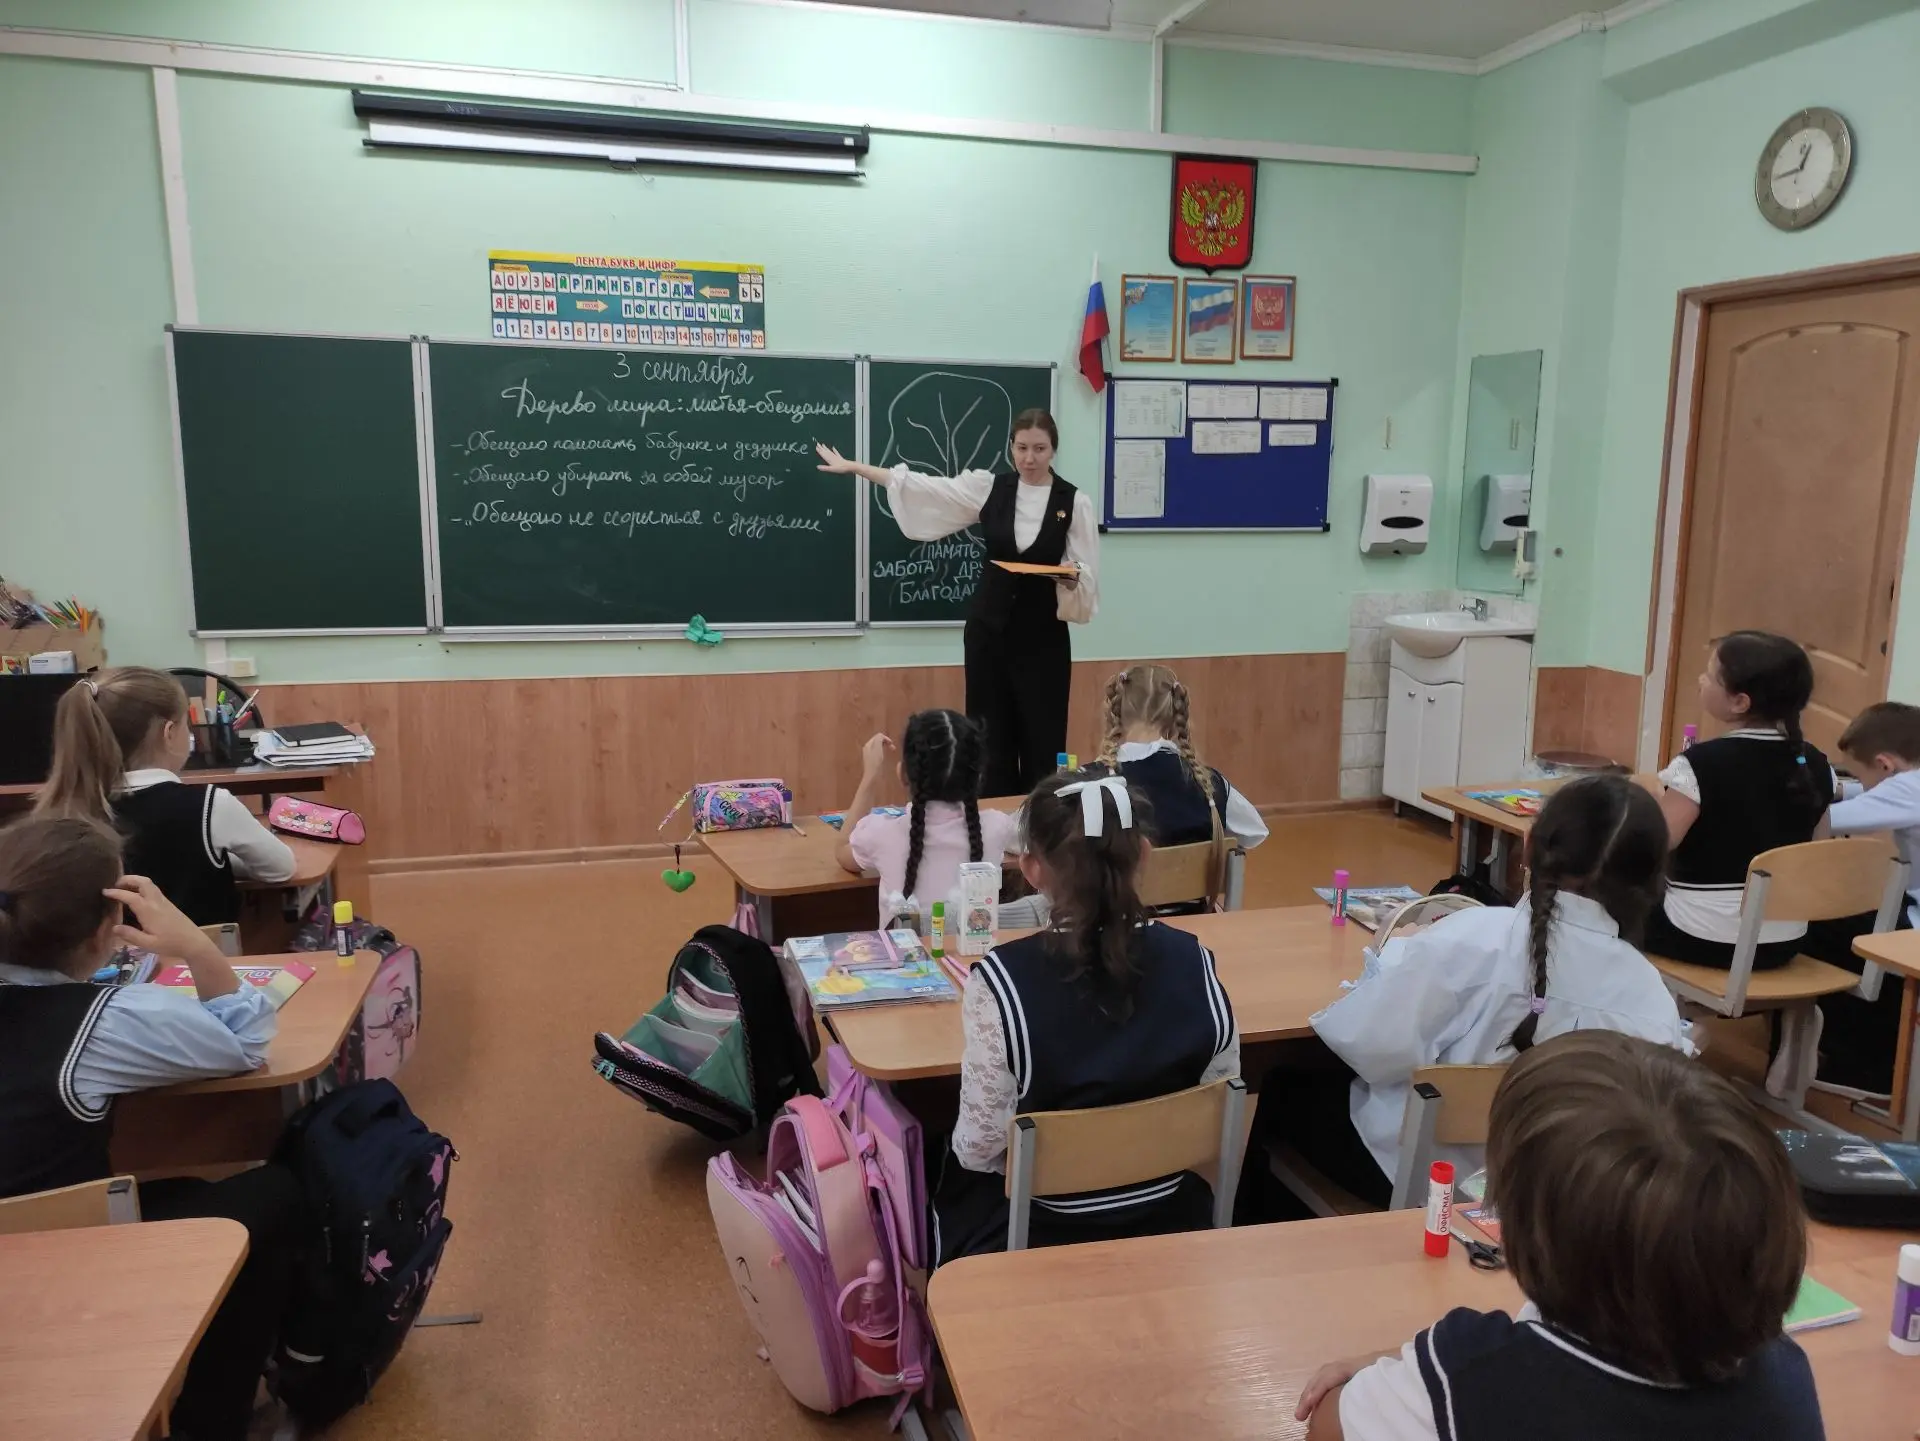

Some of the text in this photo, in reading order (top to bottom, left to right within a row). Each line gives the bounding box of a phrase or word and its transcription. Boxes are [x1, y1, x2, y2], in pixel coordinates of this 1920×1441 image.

[576, 256, 677, 270] ЛЕНТА БУКВ И ЦИФР
[627, 329, 636, 338] 10
[641, 330, 649, 339] 11
[653, 330, 663, 339] 12
[665, 330, 675, 340] 13
[679, 331, 688, 340] 14
[691, 331, 700, 341] 15
[703, 332, 713, 341] 16
[716, 333, 725, 342] 17
[728, 333, 737, 343] 18
[741, 334, 750, 343] 19
[753, 334, 763, 344] 20
[613, 352, 754, 393] 3 сентября
[501, 378, 596, 424] Дерево
[553, 439, 637, 451] помогать
[645, 431, 713, 460] бабушке
[716, 441, 727, 450] и
[552, 463, 632, 496] убирать
[640, 471, 658, 485] за
[663, 464, 713, 484] собой
[569, 511, 594, 526] не
[603, 510, 703, 538] ссориться
[713, 511, 724, 524] с
[927, 543, 980, 560] ПАМЯТЬ
[873, 559, 934, 578] ЗАБОТА
[1440, 1190, 1452, 1233] ОФИСМАГ
